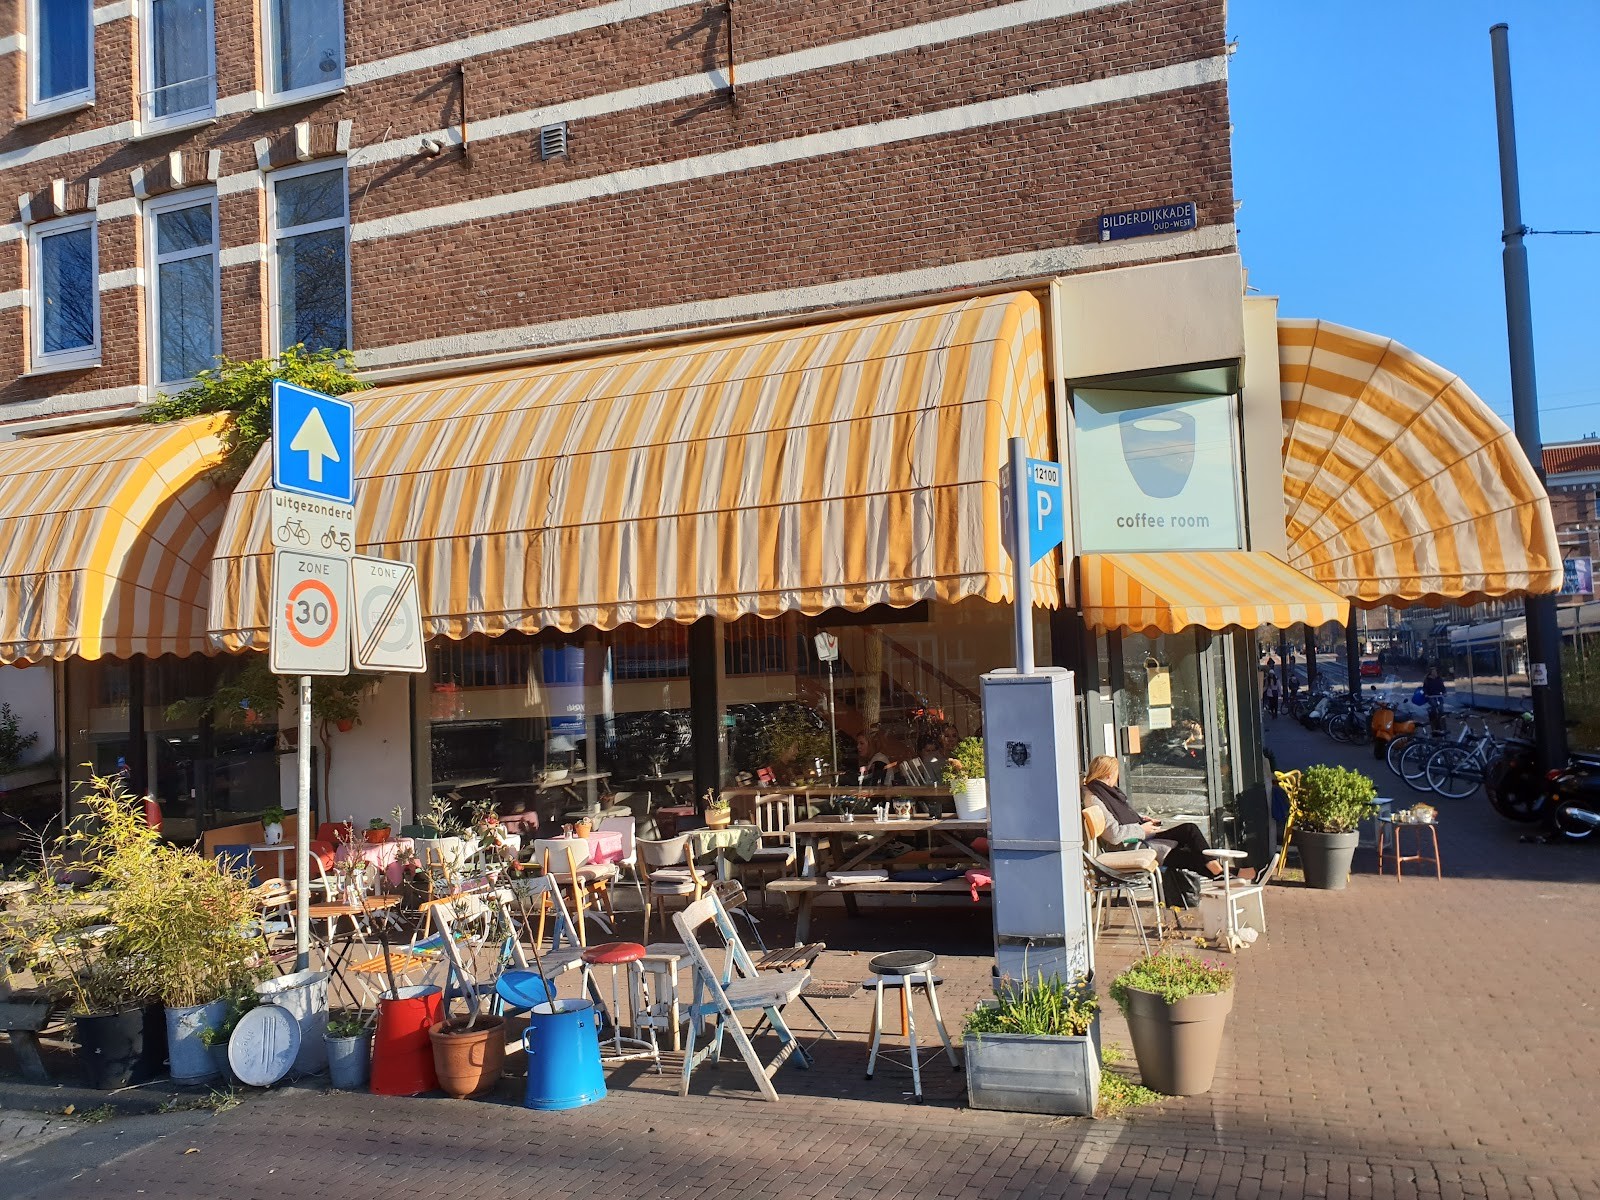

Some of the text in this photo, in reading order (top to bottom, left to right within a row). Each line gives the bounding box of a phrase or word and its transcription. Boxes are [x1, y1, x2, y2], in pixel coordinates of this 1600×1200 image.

[1103, 205, 1191, 228] BILDERDIJKKADE
[1153, 218, 1191, 231] OUD-WEST
[1035, 467, 1057, 483] 12100
[276, 496, 352, 520] uitgezonderd
[1037, 490, 1052, 531] P
[1116, 512, 1210, 528] coffee room
[298, 561, 330, 575] ZONE
[371, 565, 397, 579] ZONE
[295, 600, 329, 626] 30
